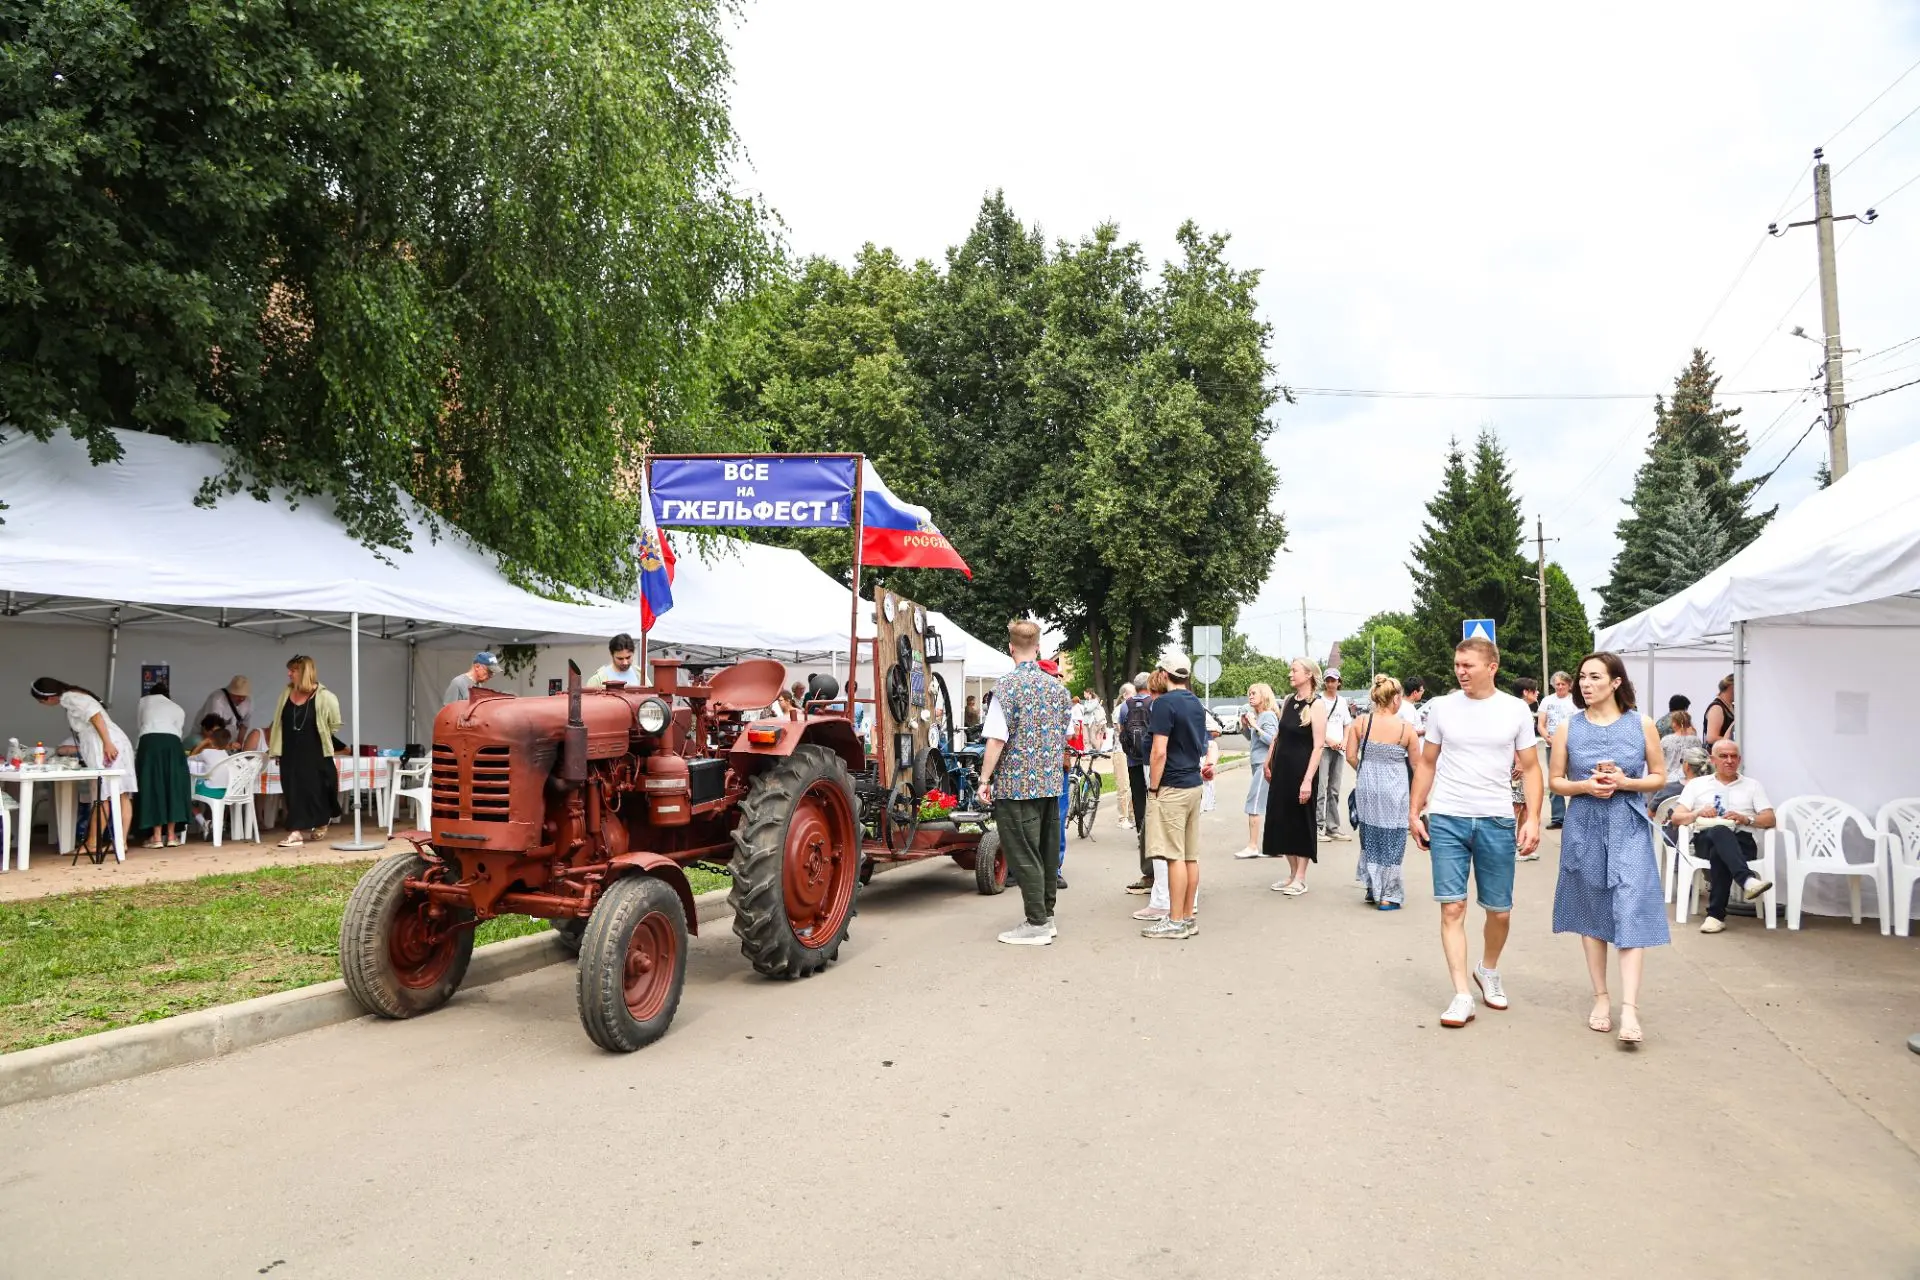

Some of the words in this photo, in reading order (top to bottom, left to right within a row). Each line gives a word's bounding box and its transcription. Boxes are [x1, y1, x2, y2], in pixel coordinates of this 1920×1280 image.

[724, 463, 769, 481] ВСЕ
[736, 486, 755, 497] НА
[903, 535, 949, 549] РОССИ
